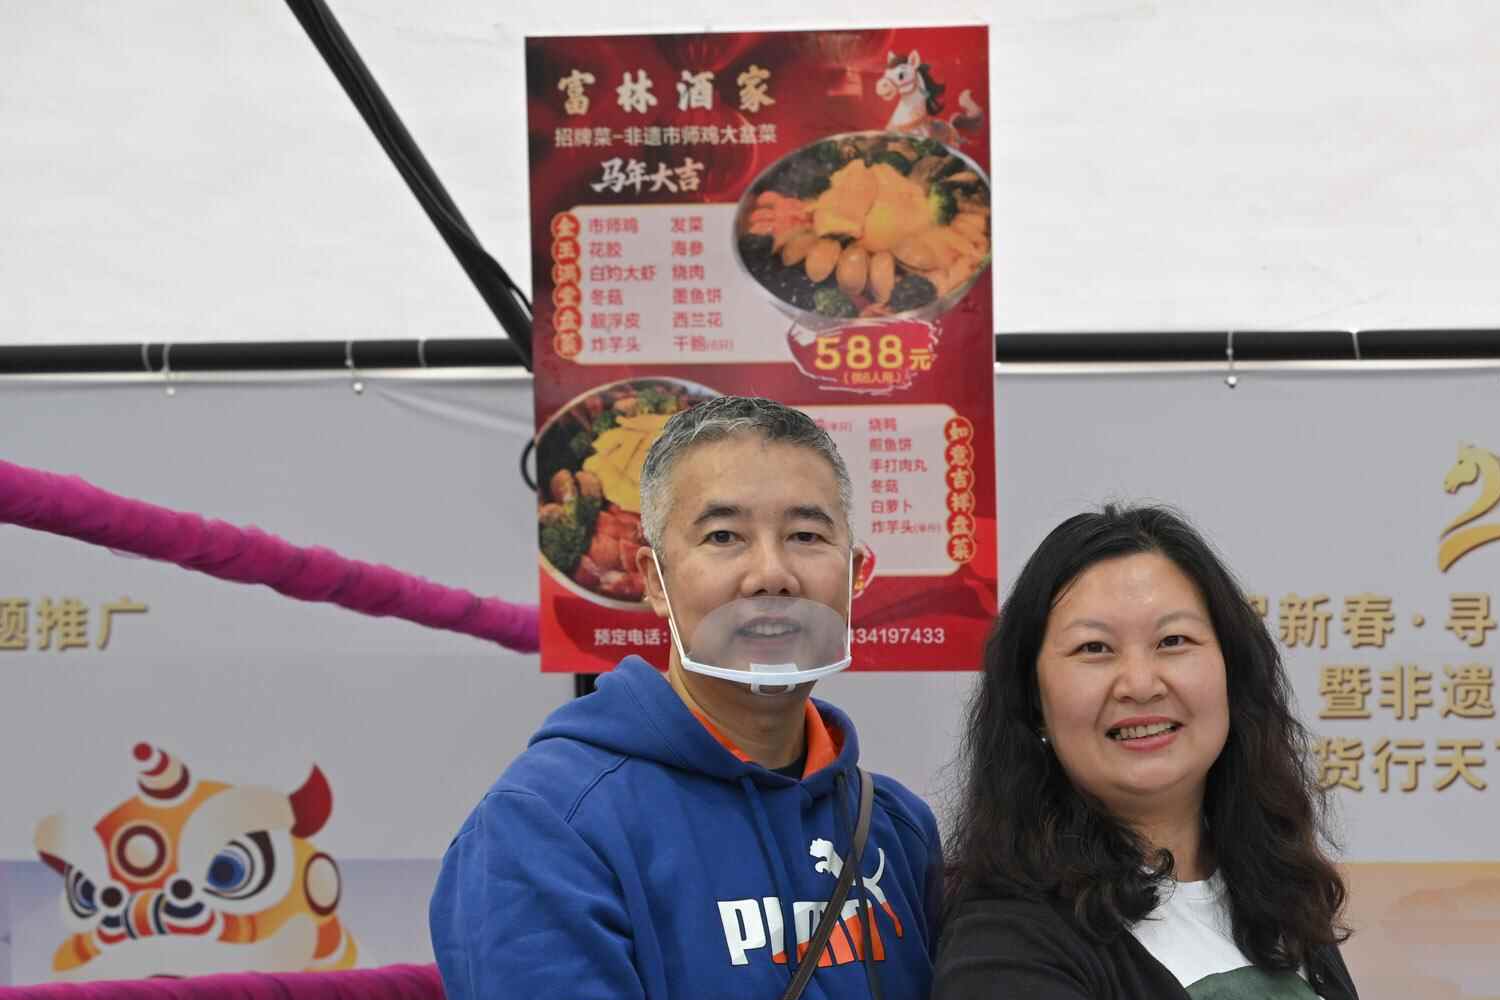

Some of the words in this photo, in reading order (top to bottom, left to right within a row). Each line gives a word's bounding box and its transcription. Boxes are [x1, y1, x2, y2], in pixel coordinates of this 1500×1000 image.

[558, 64, 776, 115] 富林酒家
[590, 157, 704, 193] 马年大吉
[671, 216, 703, 232] 发菜
[590, 241, 622, 257] 花胶
[672, 240, 703, 256] 海参
[590, 265, 656, 281] 白灼大虾
[672, 265, 704, 281] 烧肉
[673, 312, 721, 327] 西兰花
[591, 336, 640, 352] 炸芋头
[815, 335, 932, 370] 588元
[870, 458, 928, 472] 手打肉丸
[872, 500, 912, 513] 白萝卜
